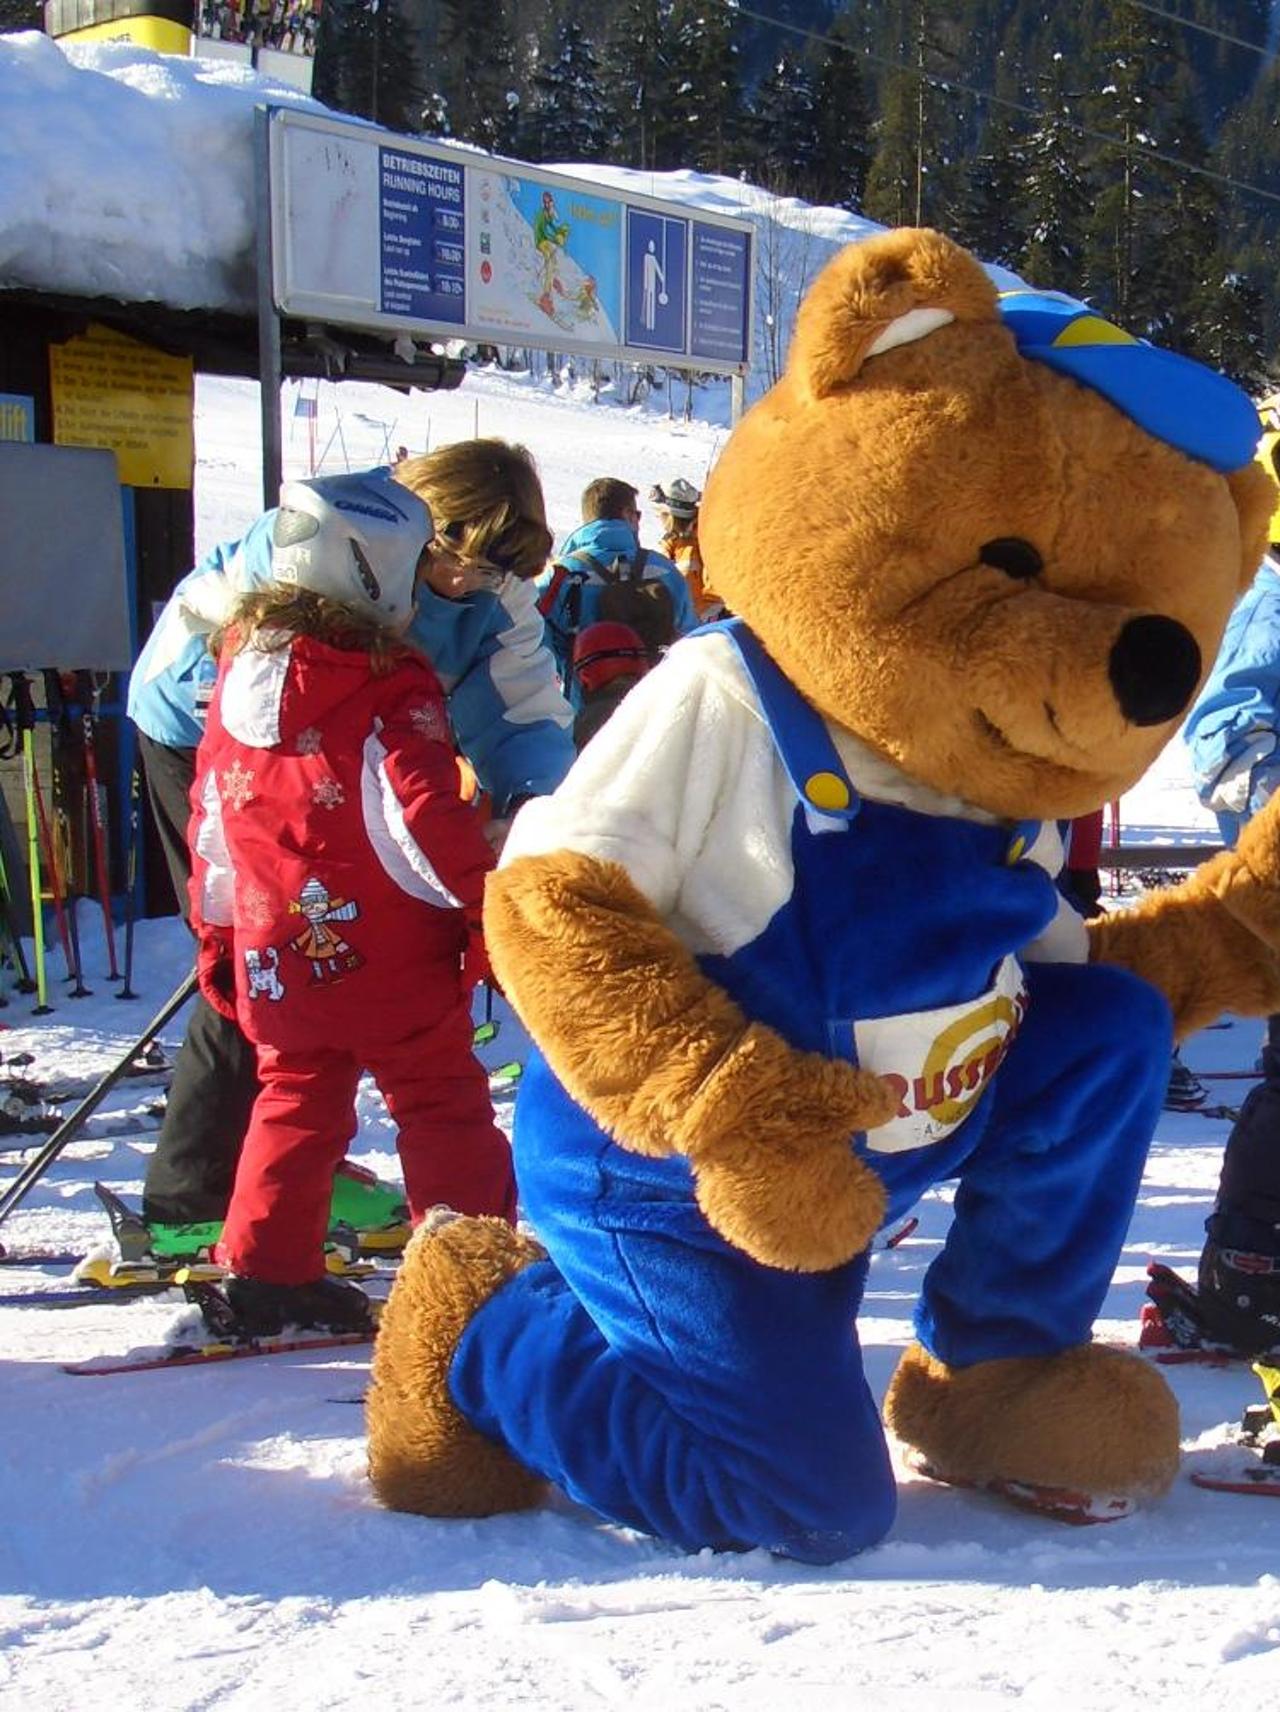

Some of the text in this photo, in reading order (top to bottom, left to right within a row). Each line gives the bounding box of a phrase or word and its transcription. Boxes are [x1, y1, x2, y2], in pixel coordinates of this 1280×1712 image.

[383, 154, 461, 185] BETRIEBSZEITEN
[383, 172, 427, 197] RUNNING
[428, 181, 461, 203] HOURS
[334, 500, 399, 524] CARRERA
